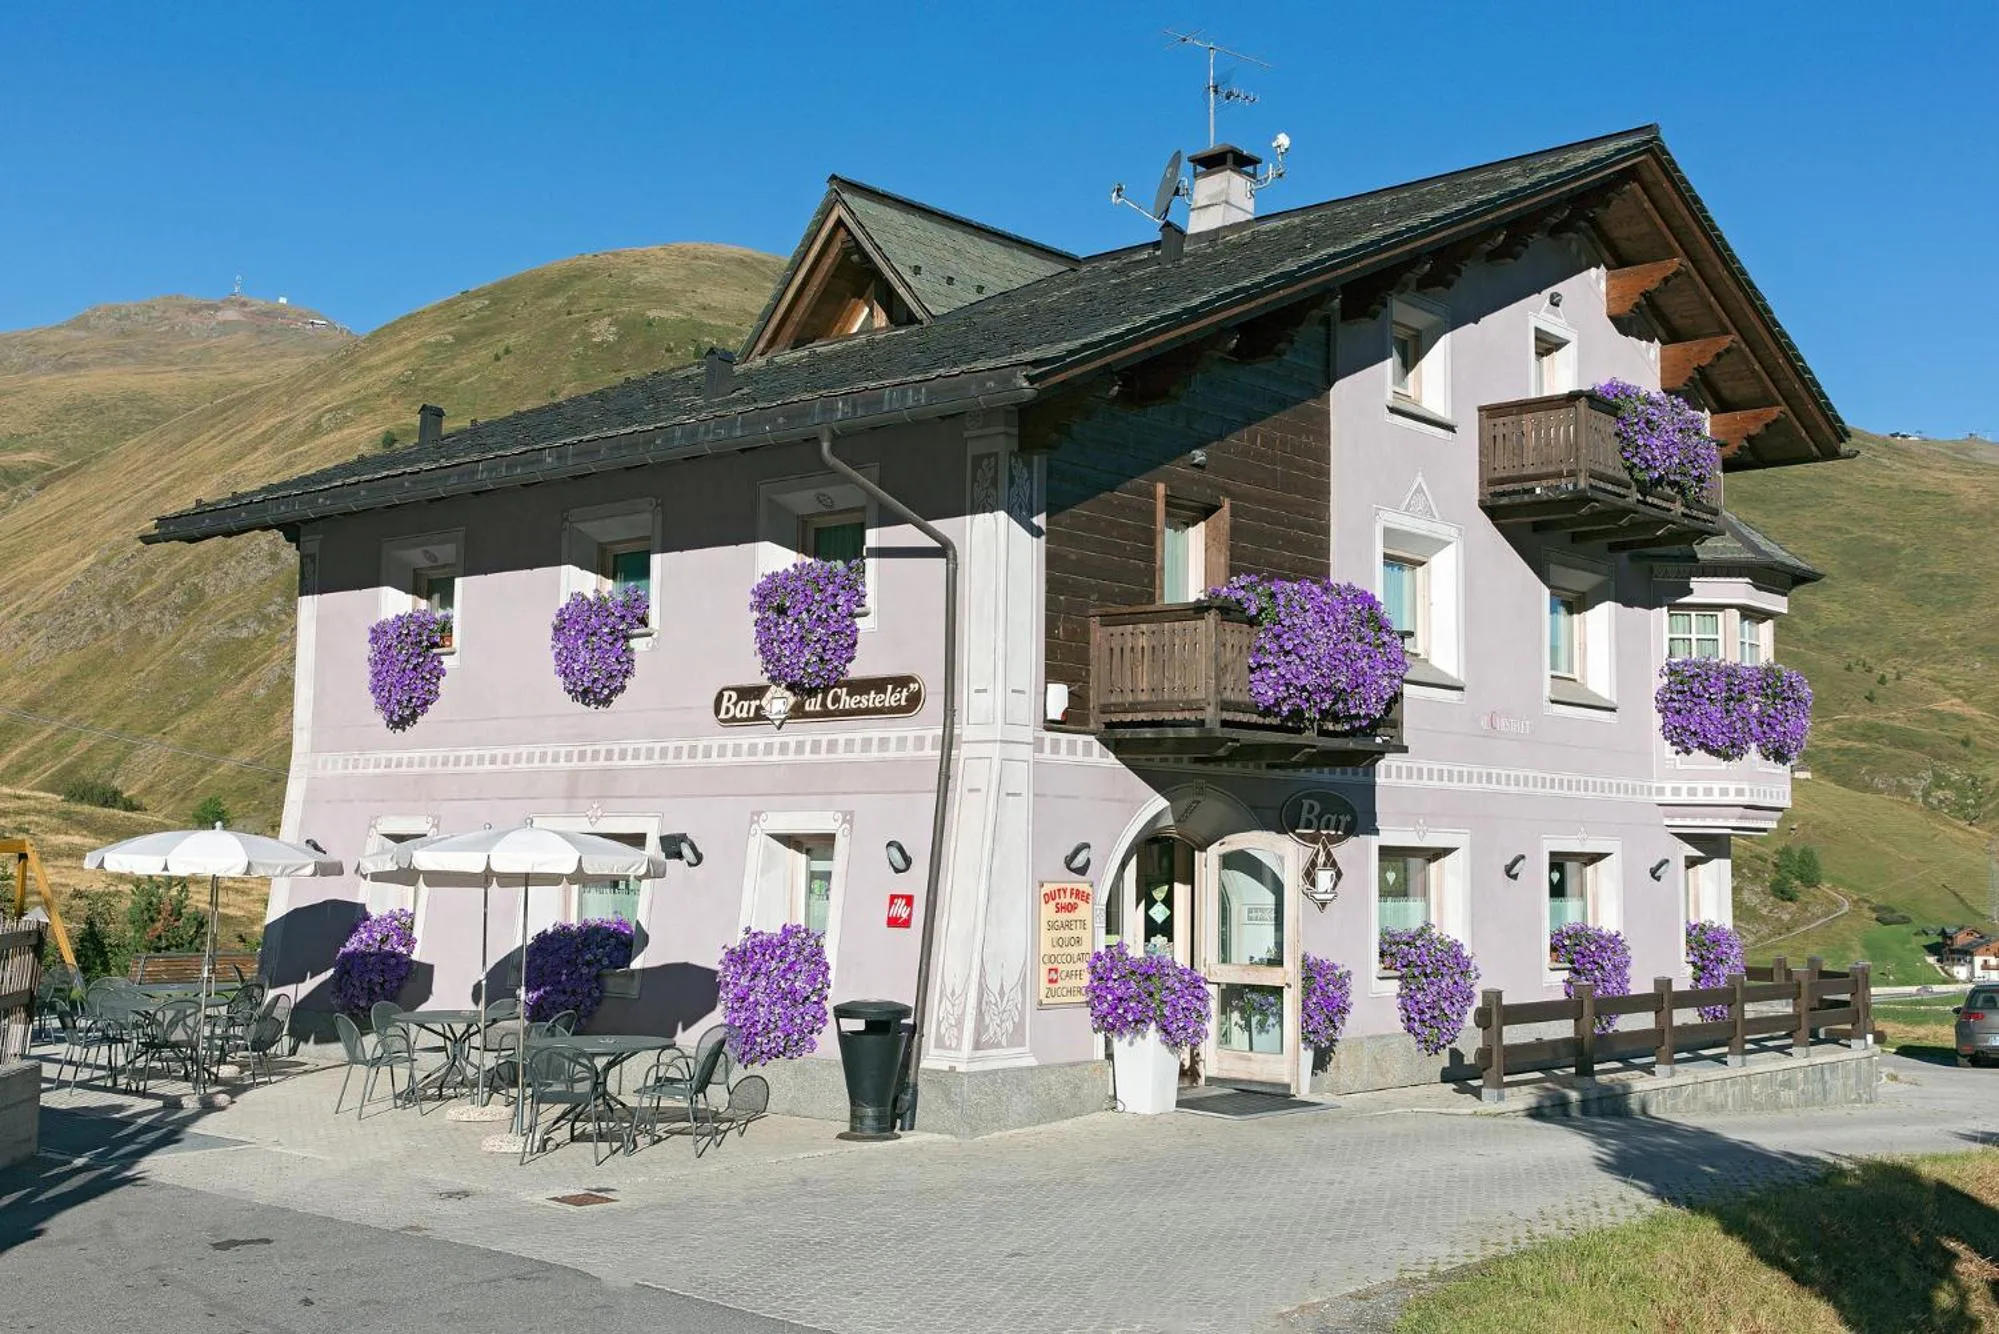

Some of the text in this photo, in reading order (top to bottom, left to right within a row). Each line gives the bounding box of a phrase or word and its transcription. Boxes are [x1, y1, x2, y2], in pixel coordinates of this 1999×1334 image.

[719, 690, 761, 719] Bar
[1295, 799, 1352, 834] Bar
[1043, 887, 1091, 905] DUTY FREE
[888, 896, 911, 924] illy
[1055, 902, 1079, 914] SHOP
[1047, 919, 1087, 931] SIGARETTE
[1051, 936, 1082, 948] LIQUORI
